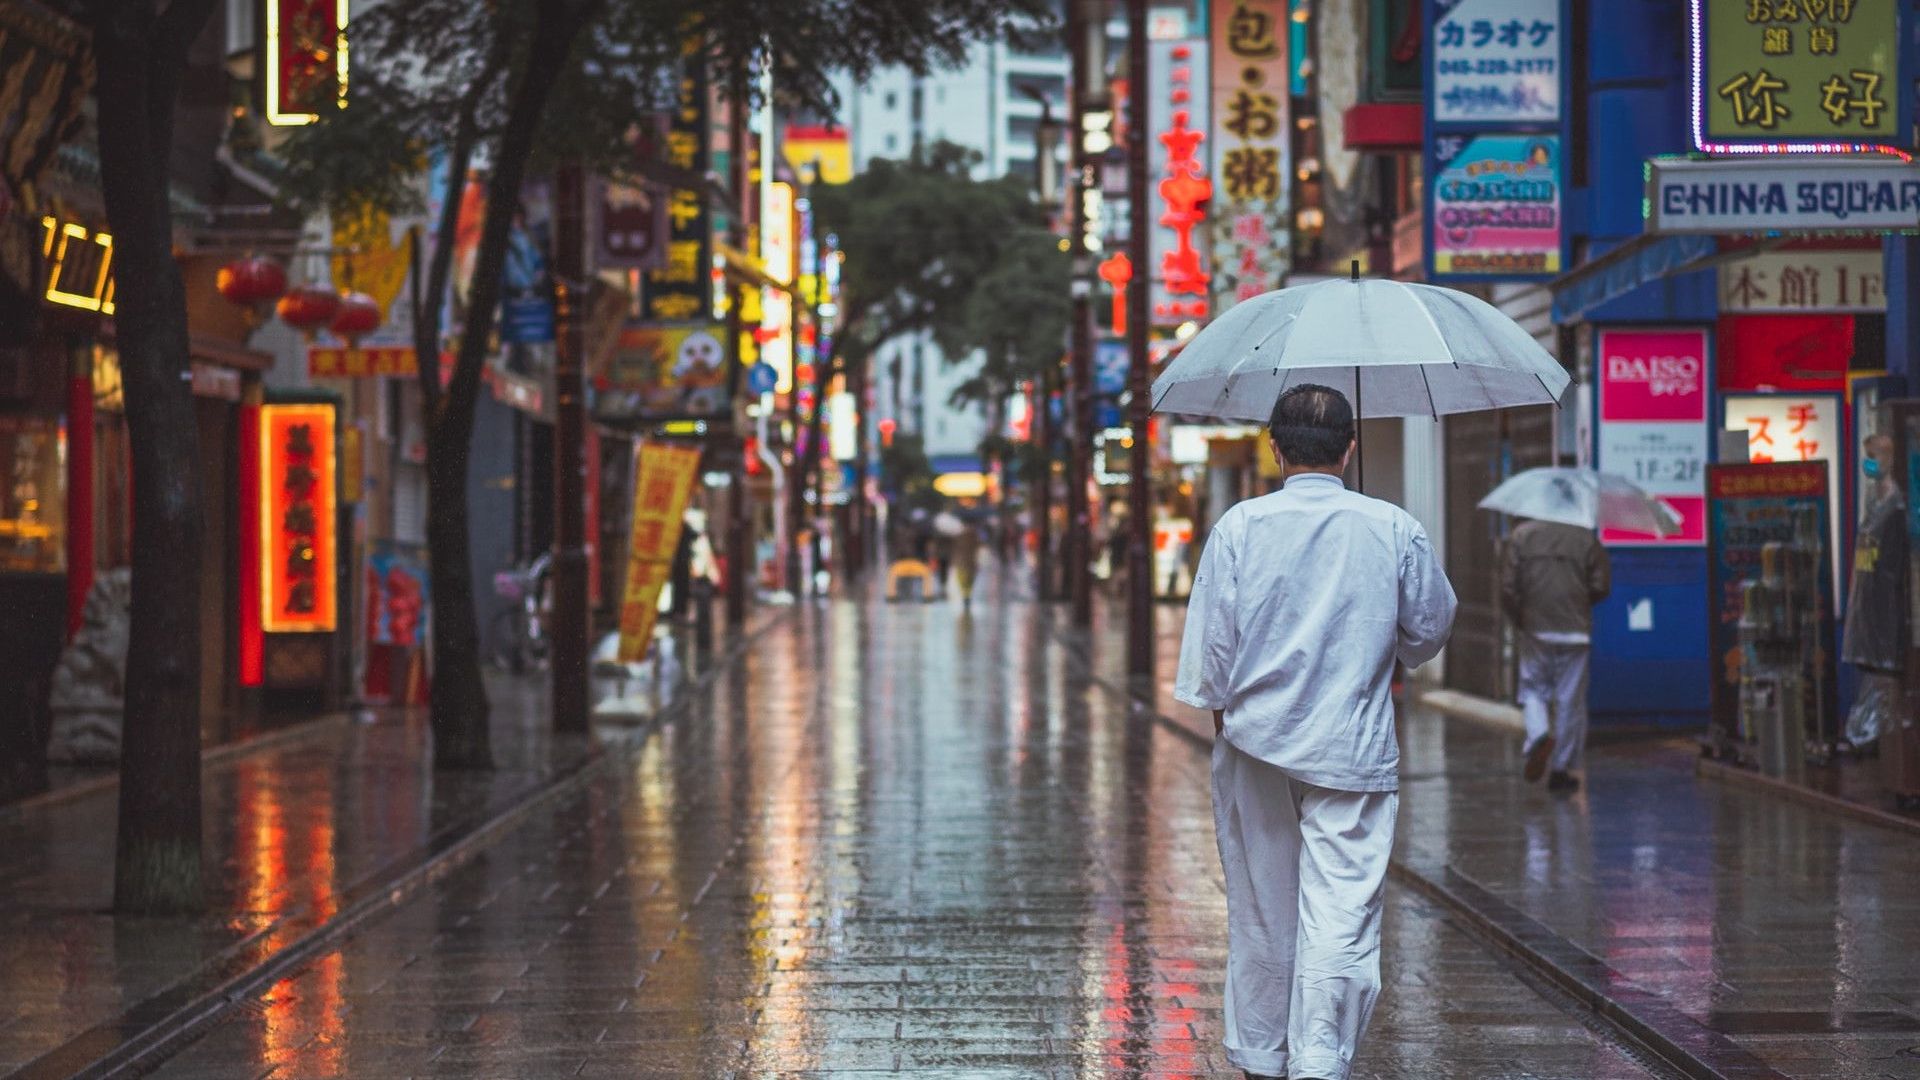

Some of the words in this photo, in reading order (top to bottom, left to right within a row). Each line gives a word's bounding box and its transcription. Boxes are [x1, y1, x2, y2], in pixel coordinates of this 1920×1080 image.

[1440, 19, 1554, 48] カラオケ
[1720, 71, 1884, 126] 你好
[1663, 183, 1788, 216] CHINA
[1608, 355, 1700, 382] DAISO
